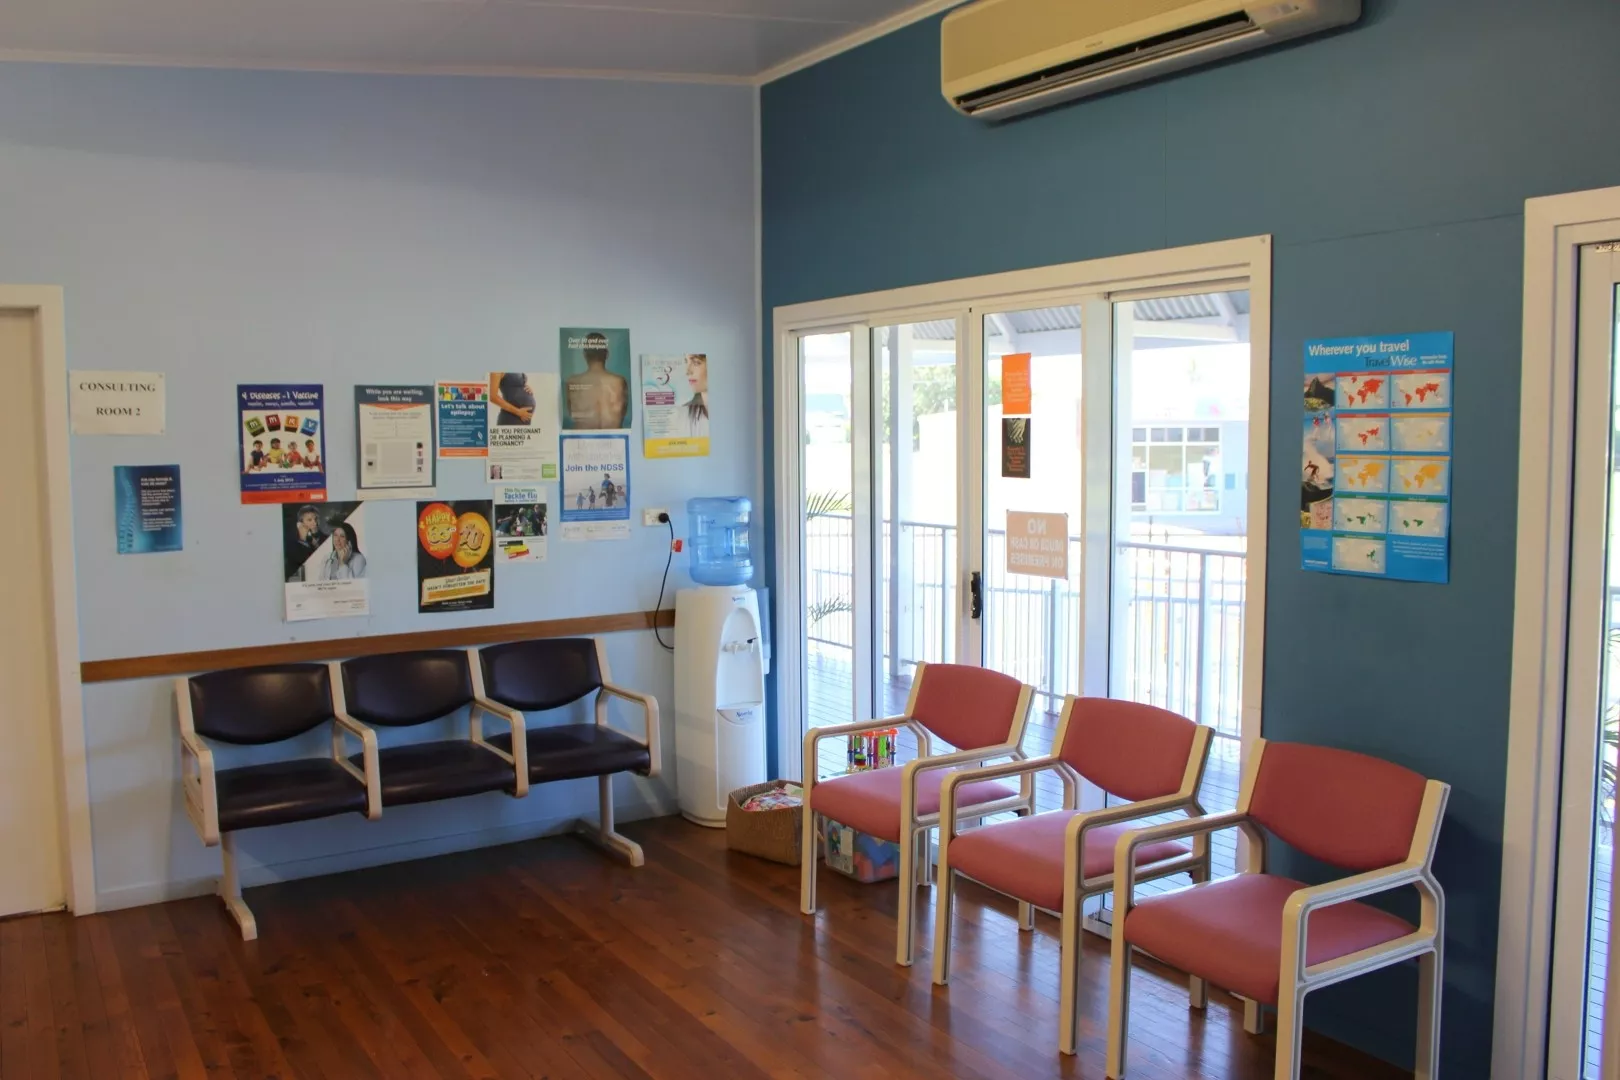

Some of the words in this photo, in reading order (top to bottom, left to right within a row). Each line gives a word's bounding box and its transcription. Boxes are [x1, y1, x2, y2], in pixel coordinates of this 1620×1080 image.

[1308, 344, 1354, 357] Wherever
[1356, 344, 1376, 356] you
[1380, 339, 1410, 352] travel
[79, 382, 156, 392] CONSULTING
[250, 392, 280, 400] Diseases
[292, 391, 319, 400] Vaccine
[96, 406, 133, 416] ROOM
[136, 408, 141, 416] 2
[565, 464, 583, 472] Join
[585, 464, 598, 472] the
[600, 463, 624, 472] NDSS
[425, 511, 451, 525] HAPPY
